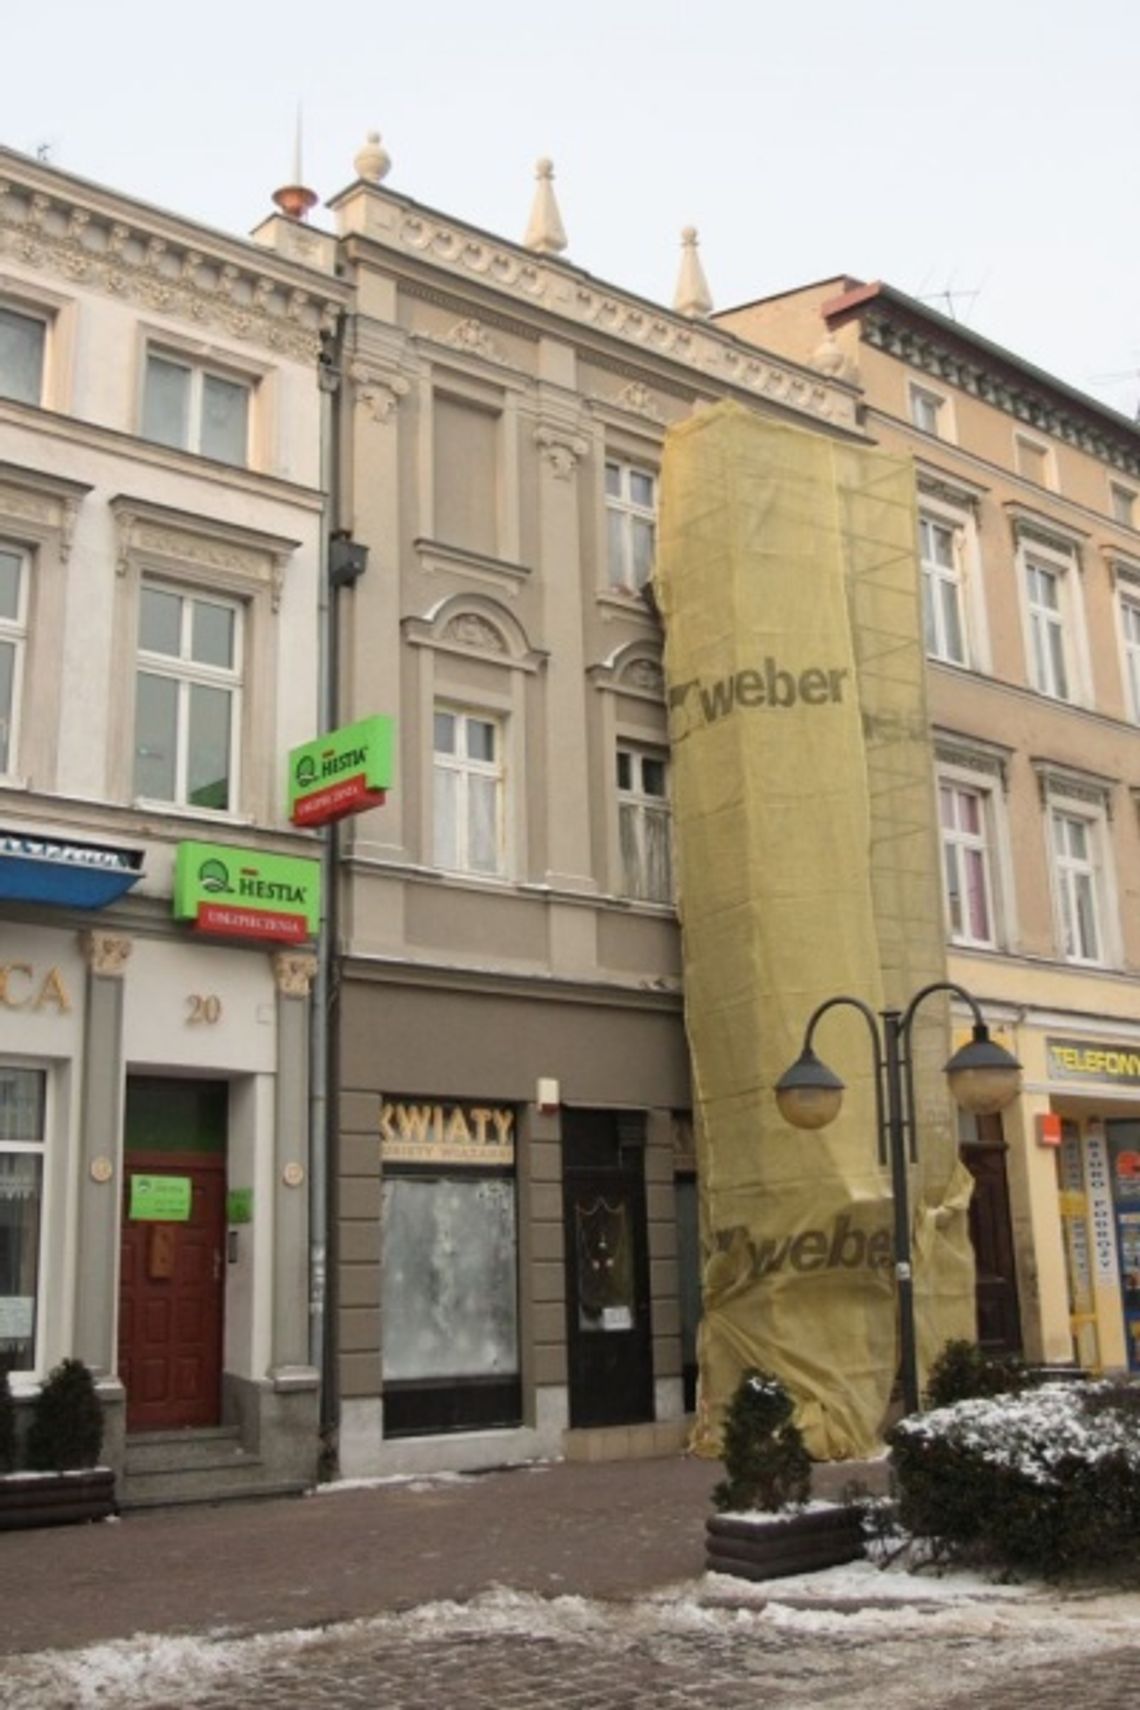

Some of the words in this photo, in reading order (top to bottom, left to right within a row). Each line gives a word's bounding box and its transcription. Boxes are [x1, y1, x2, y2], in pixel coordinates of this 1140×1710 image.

[700, 656, 848, 723] weber
[322, 748, 367, 778] HESTIA
[239, 878, 305, 904] HESTIA
[185, 994, 221, 1025] 20
[381, 1103, 514, 1145] KWIATY
